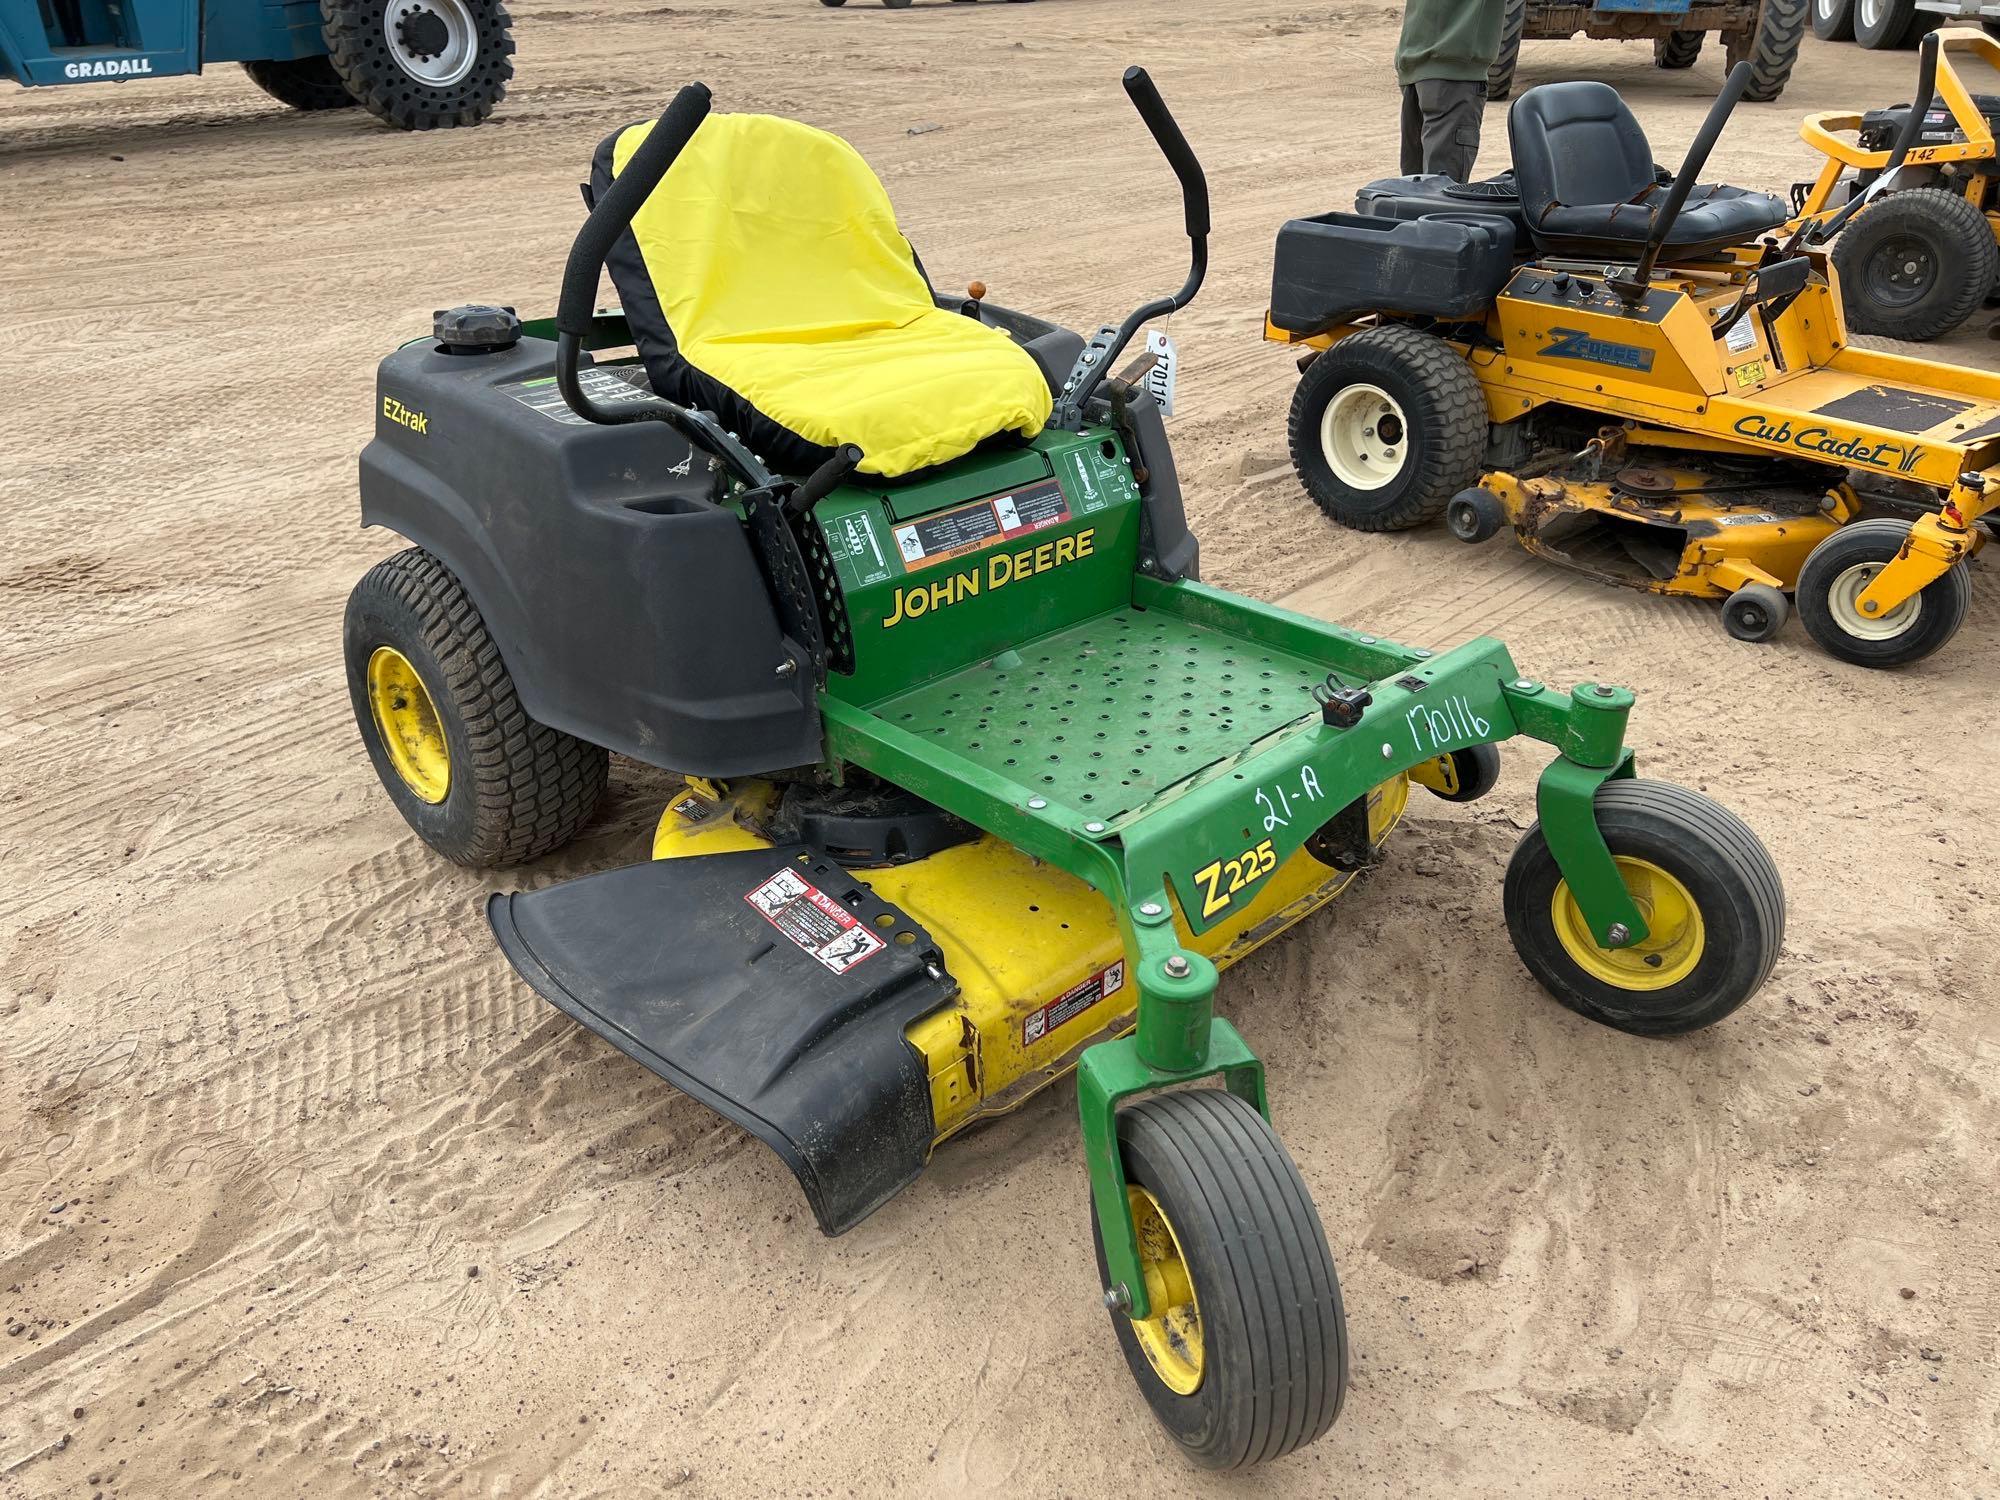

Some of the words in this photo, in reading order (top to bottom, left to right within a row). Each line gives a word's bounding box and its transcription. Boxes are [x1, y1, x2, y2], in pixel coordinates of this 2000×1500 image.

[65, 59, 152, 78] GRADALL
[384, 396, 428, 435] EZtrak
[1734, 415, 1792, 443] Cub
[1794, 428, 1901, 467] Cadet
[883, 567, 980, 629] JOHN
[987, 528, 1096, 592] DEERE
[1406, 695, 1490, 752] 170116
[1255, 765, 1325, 832] 21-A
[1193, 838, 1277, 919] Z225
[818, 895, 852, 924] DANGER
